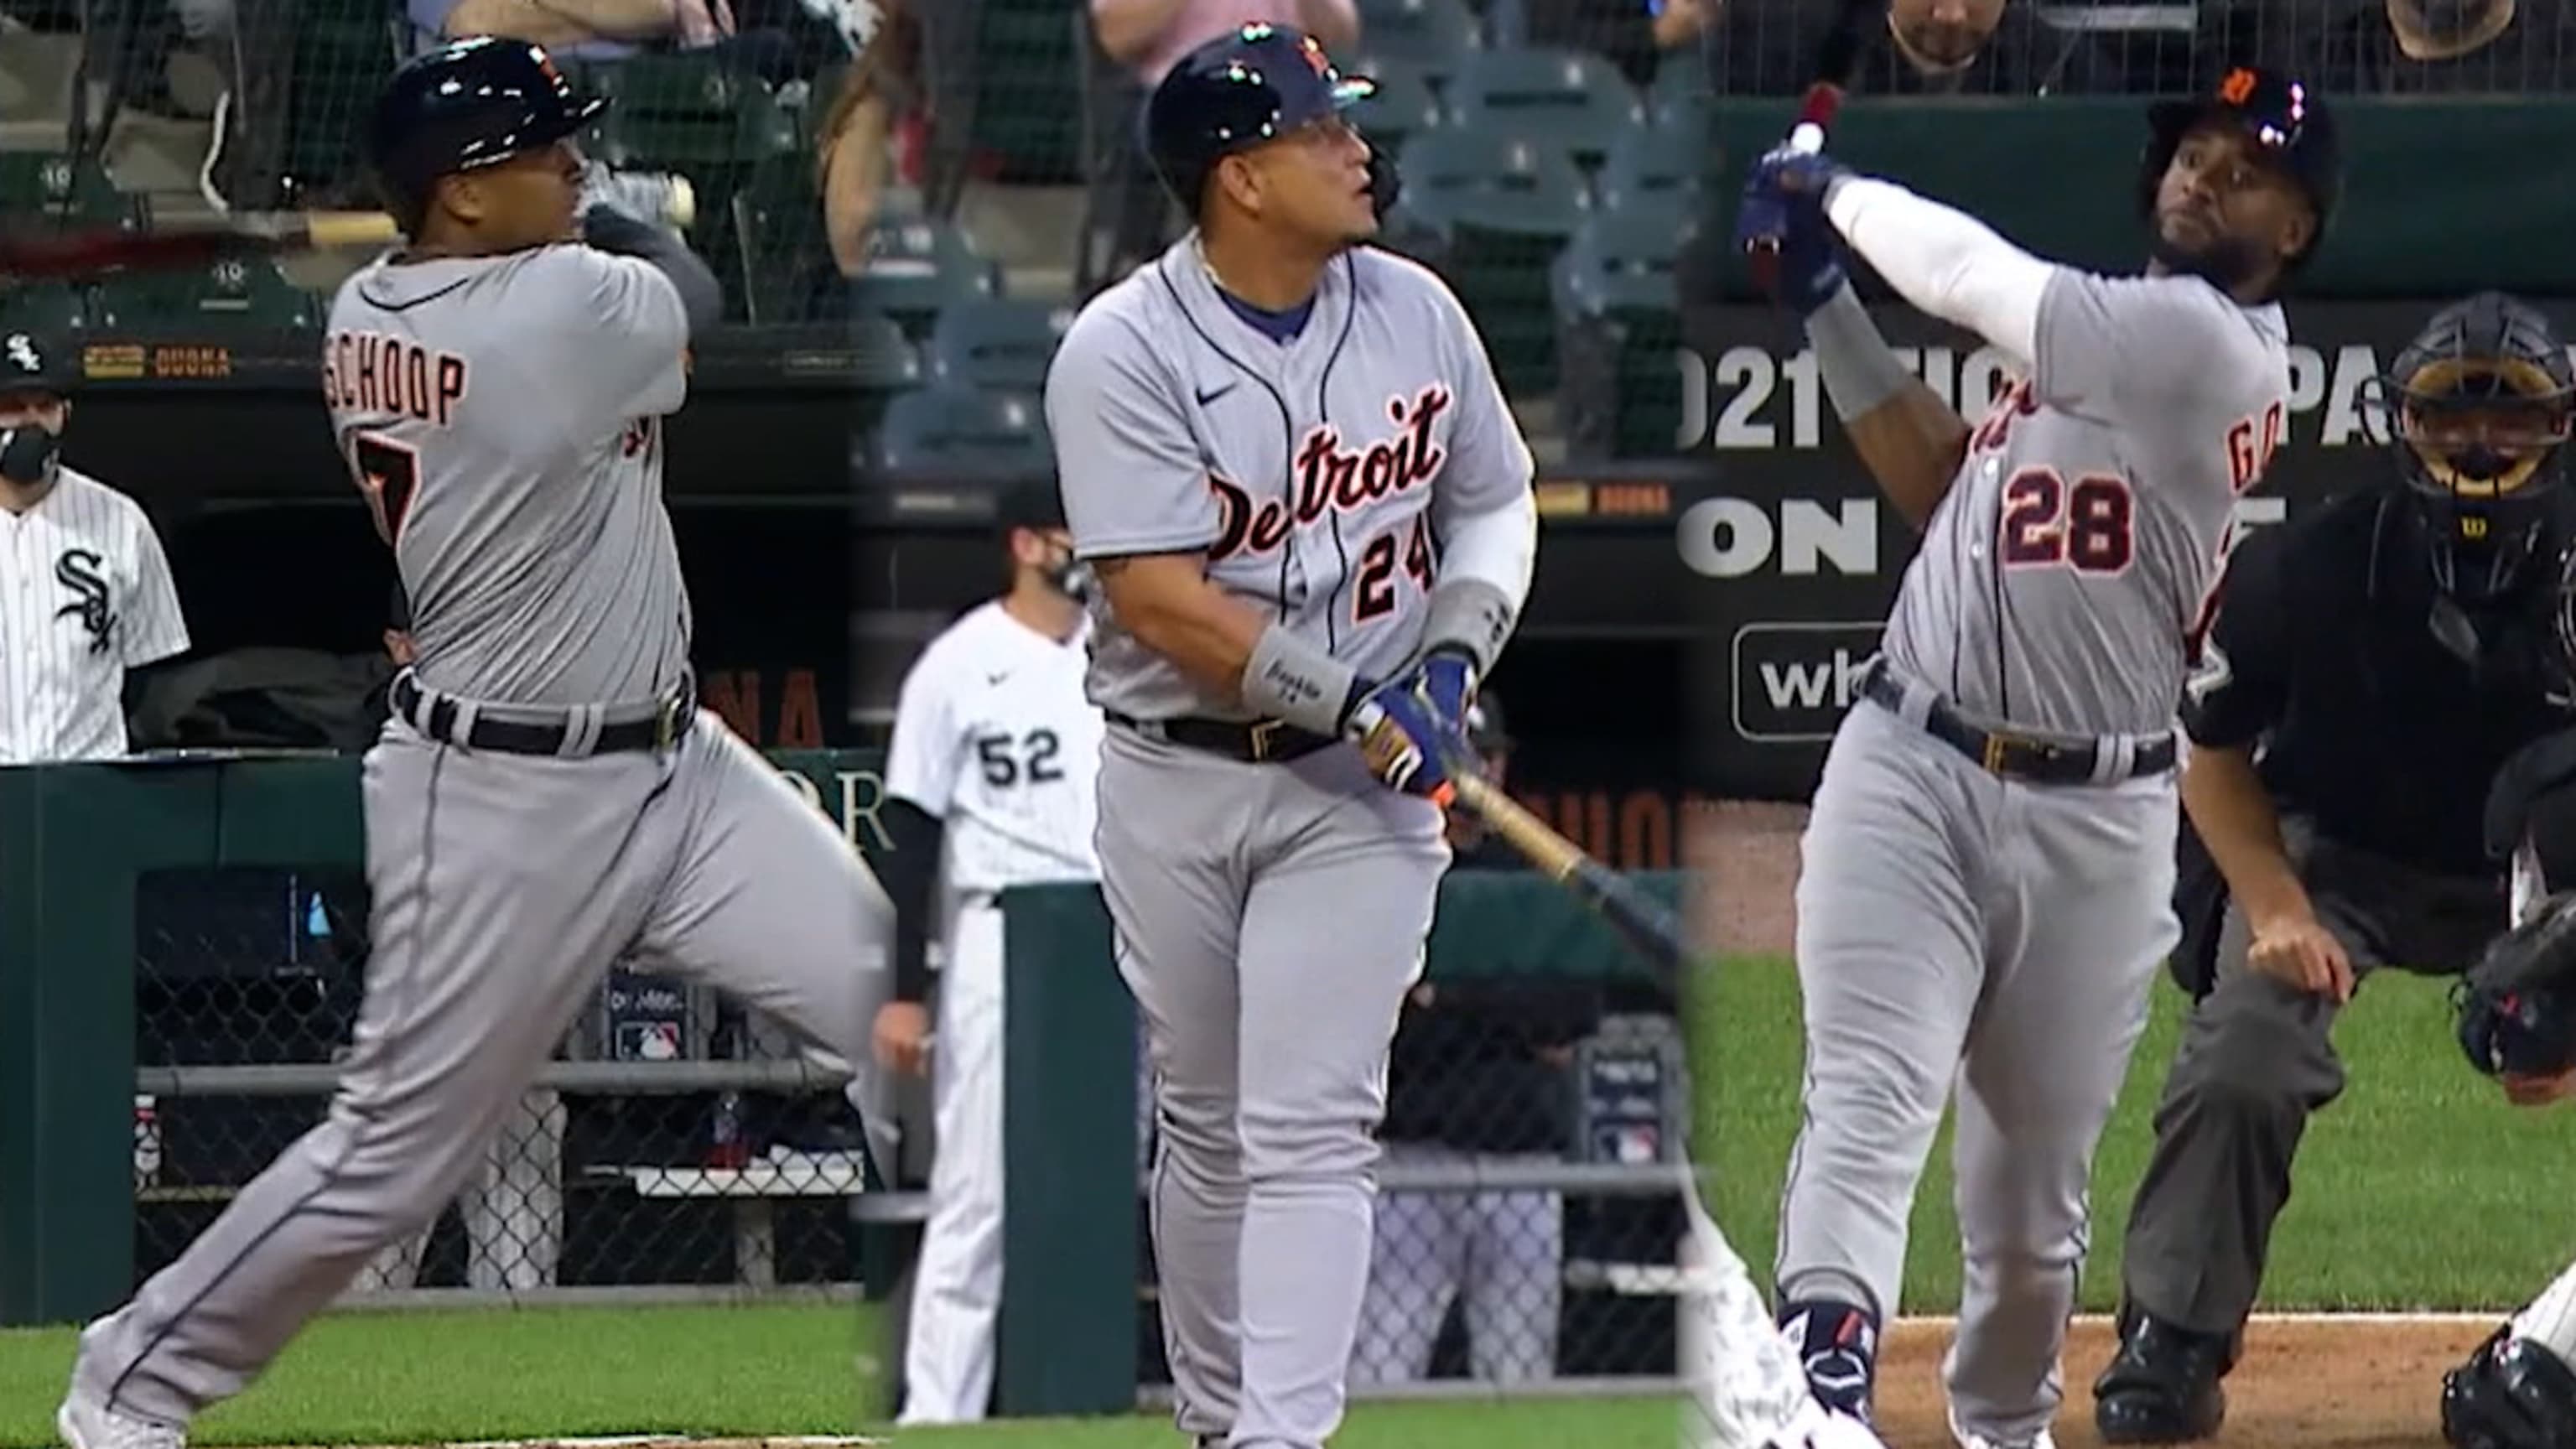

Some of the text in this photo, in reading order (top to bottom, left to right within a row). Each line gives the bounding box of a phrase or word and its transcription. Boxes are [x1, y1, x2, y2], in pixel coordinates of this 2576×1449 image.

[1206, 386, 1451, 564] Detroit
[2002, 465, 2137, 577] 28
[1353, 510, 1434, 622] 24
[1677, 496, 1878, 578] ON
[54, 548, 117, 655] Sox
[976, 730, 1065, 788] 52
